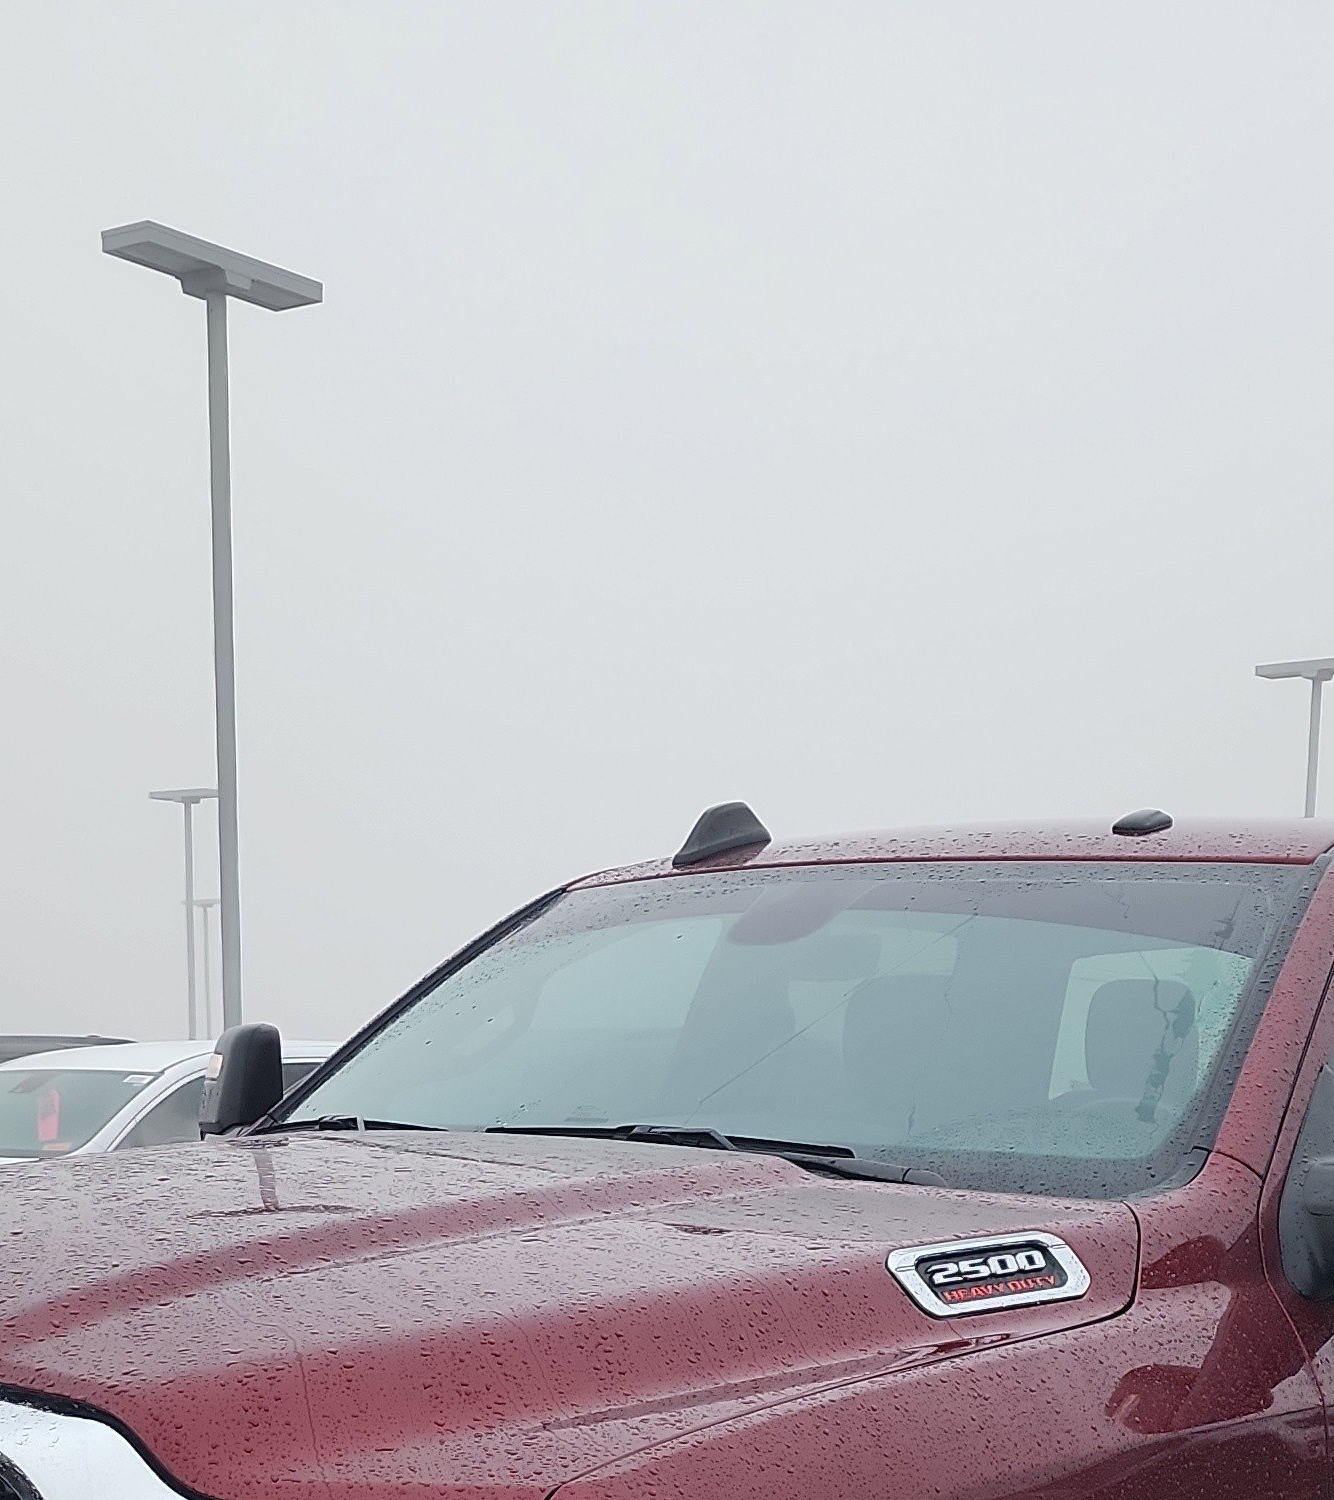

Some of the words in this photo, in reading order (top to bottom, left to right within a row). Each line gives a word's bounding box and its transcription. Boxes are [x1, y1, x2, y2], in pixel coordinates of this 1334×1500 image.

[927, 1250, 1047, 1285] 2500
[943, 1282, 1005, 1301] HEAVY
[1008, 1275, 1055, 1293] DUTY
